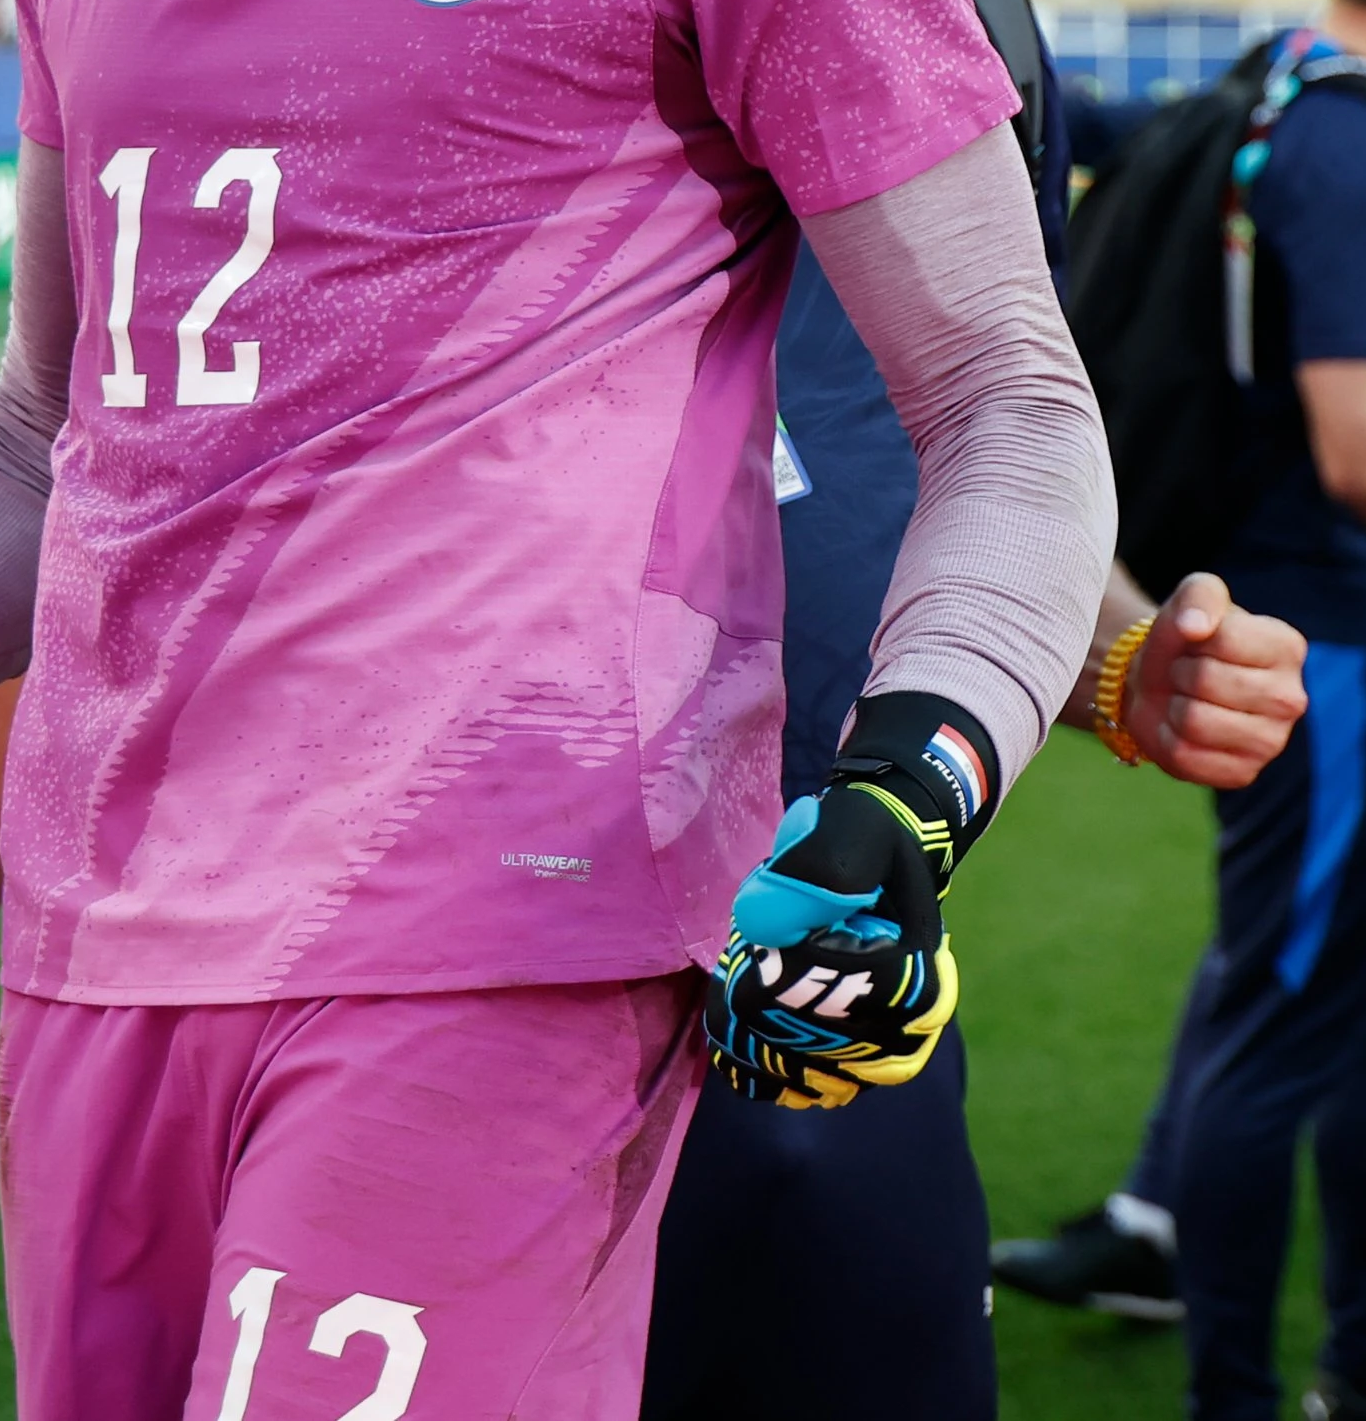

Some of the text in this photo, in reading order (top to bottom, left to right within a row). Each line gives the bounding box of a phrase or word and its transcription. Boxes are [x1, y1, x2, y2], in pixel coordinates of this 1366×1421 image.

[98, 147, 284, 408] 12
[921, 751, 968, 828] LAUTARO
[500, 852, 593, 873] ULTRAWEAVE
[216, 1266, 428, 1421] 12
